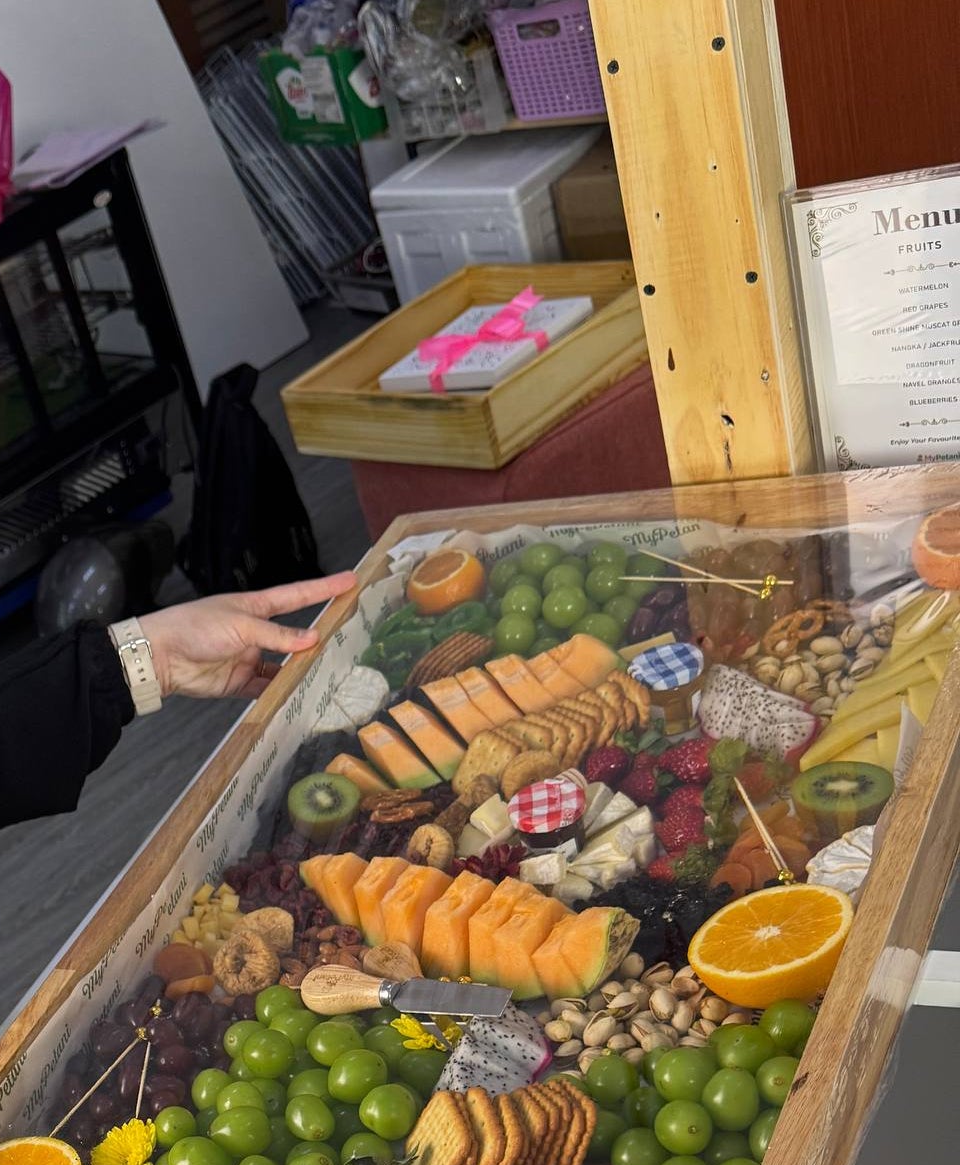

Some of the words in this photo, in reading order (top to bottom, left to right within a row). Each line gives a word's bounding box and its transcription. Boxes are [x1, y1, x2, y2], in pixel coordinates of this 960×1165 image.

[872, 206, 960, 236] Menu
[898, 241, 942, 255] FRUITS
[898, 282, 949, 295] WATERMELON
[902, 305, 917, 314] RED
[920, 301, 949, 312] GRAPES
[905, 358, 956, 370] DRAGONFRUIT
[903, 380, 926, 388] NAVEL
[927, 376, 960, 387] ORANGES
[909, 396, 958, 406] BLUEBERRIES
[890, 438, 909, 446] Enjoy
[911, 436, 928, 445] Your
